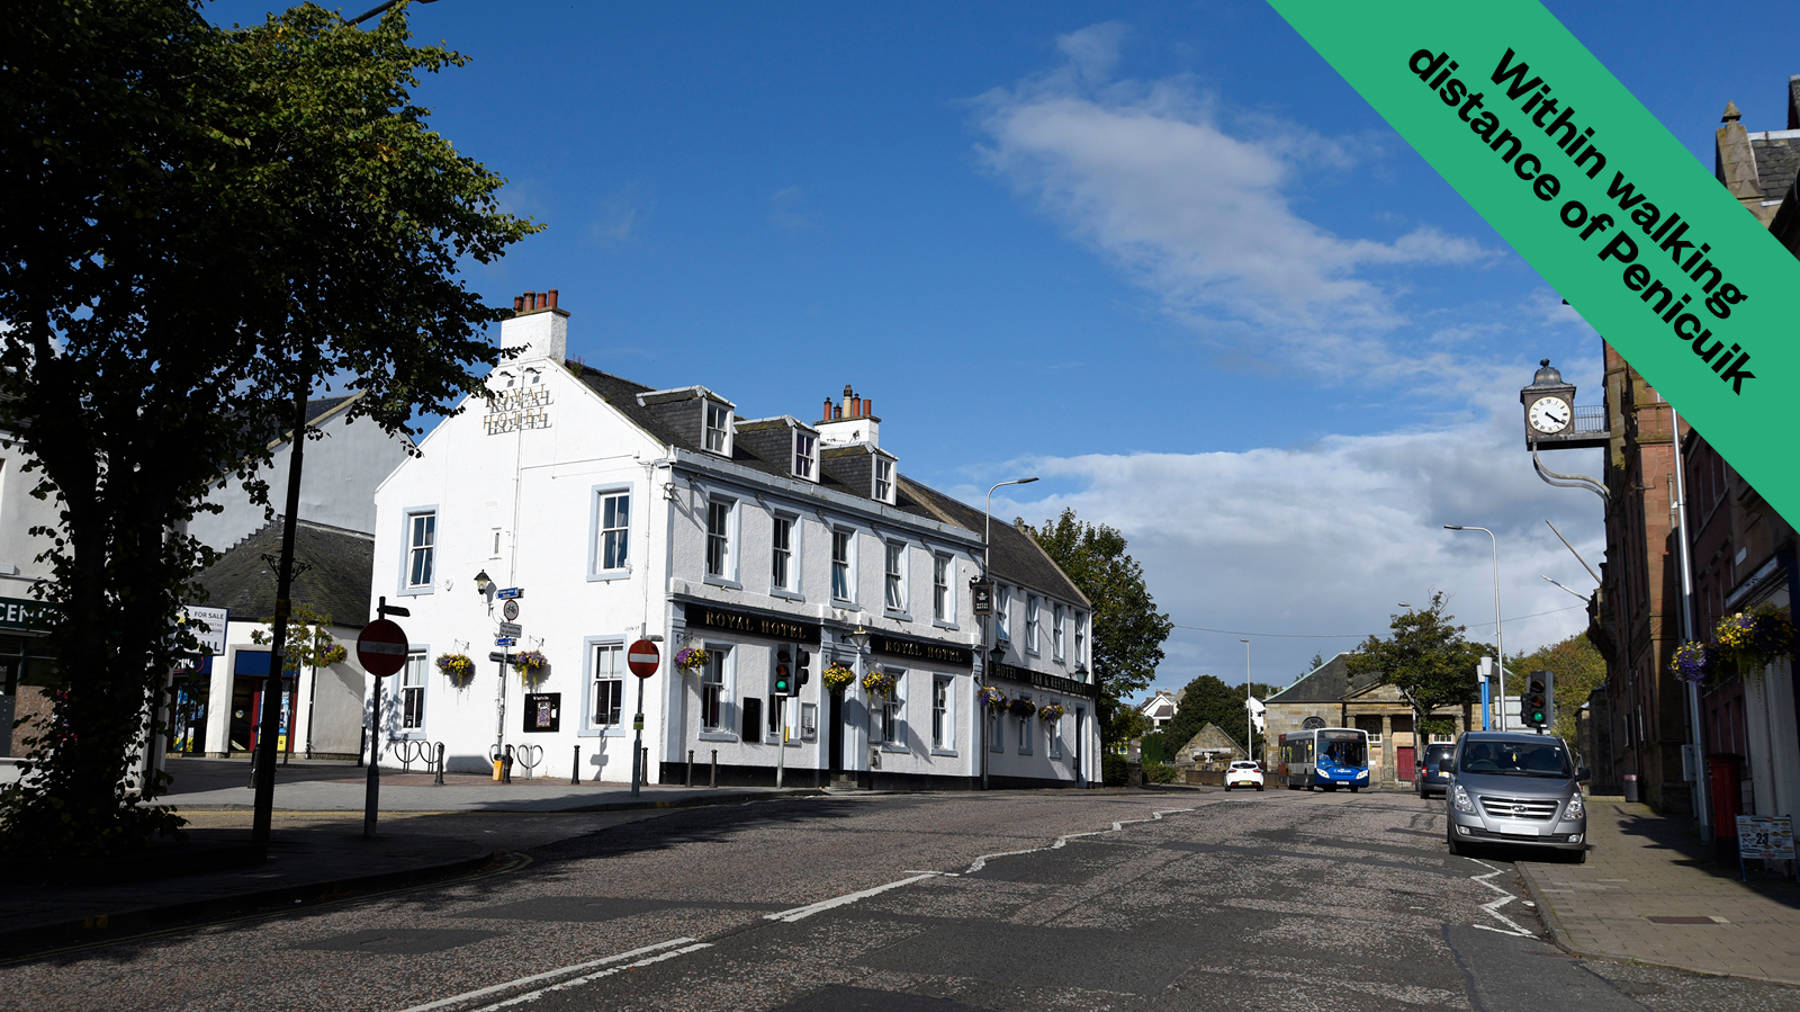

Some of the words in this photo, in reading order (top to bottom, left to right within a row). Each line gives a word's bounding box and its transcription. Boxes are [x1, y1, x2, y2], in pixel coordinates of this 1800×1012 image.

[208, 612, 224, 620] SALE
[705, 611, 754, 632] ROYAL
[761, 619, 807, 639] HOTEL
[885, 640, 922, 656] ROYAL
[927, 646, 963, 662] HOTEL
